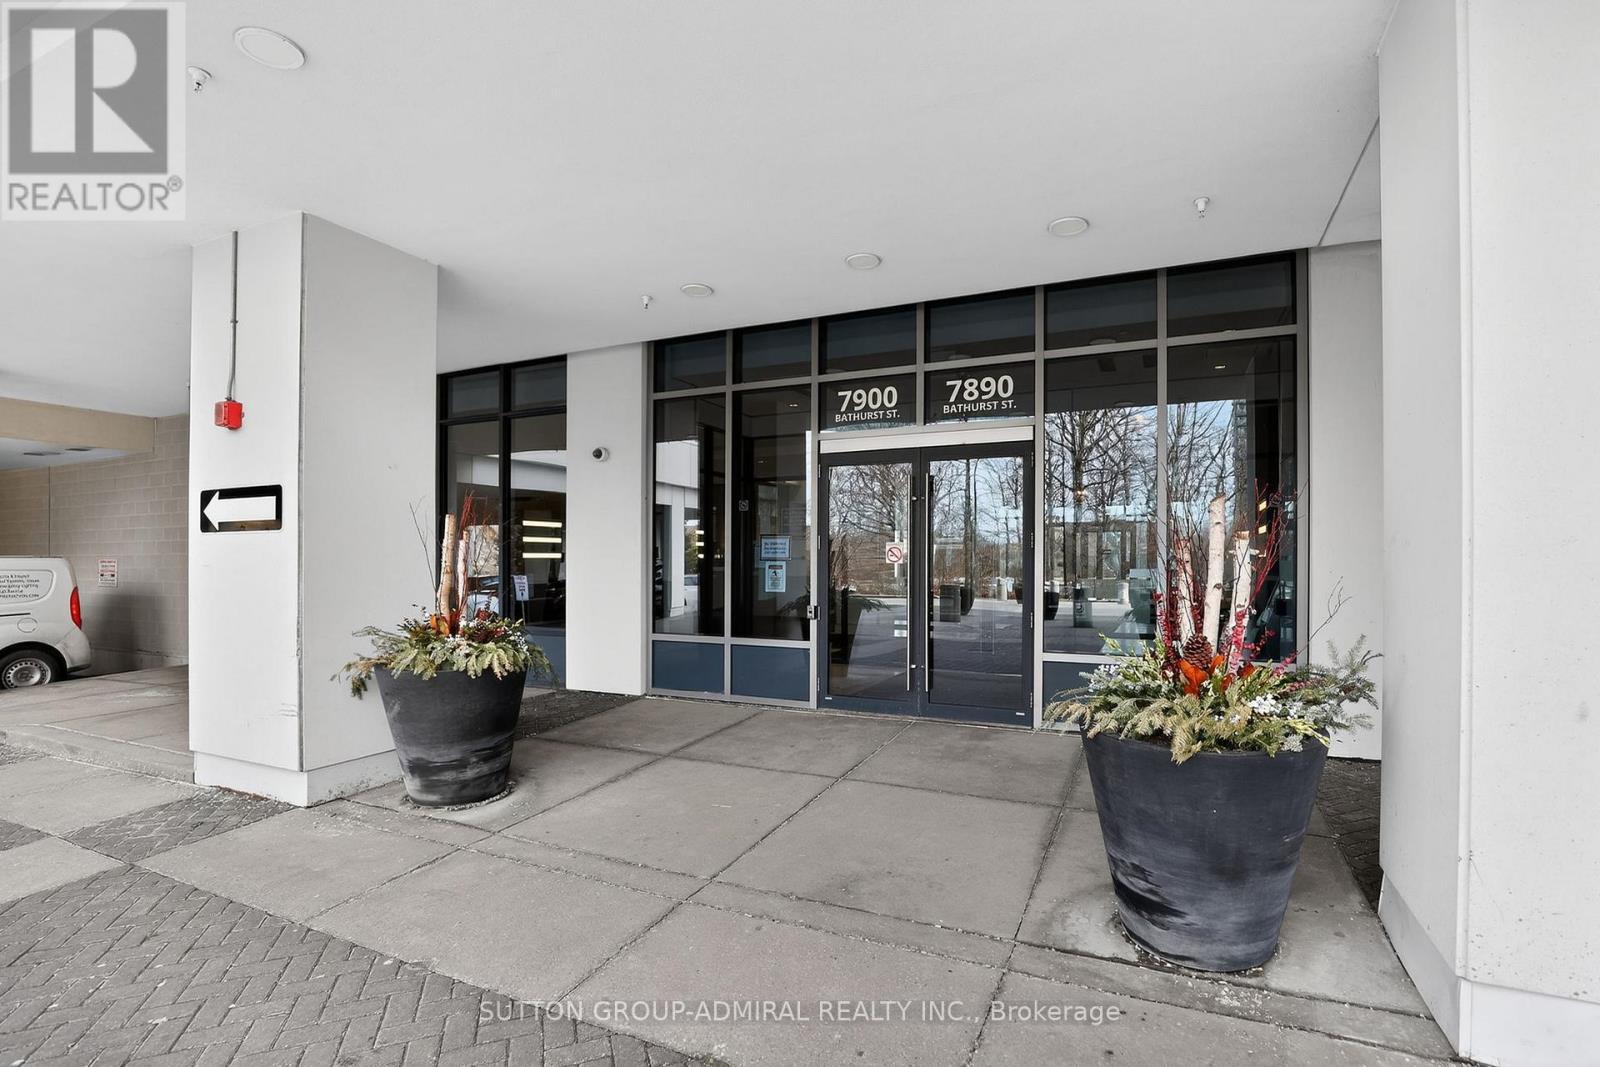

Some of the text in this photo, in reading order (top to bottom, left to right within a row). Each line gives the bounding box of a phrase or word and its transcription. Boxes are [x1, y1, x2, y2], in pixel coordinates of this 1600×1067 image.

[946, 375, 1014, 402] 7890
[837, 386, 898, 412] 7900
[943, 400, 1017, 414] BATHURST ST.
[835, 409, 900, 423] BATHURST ST.
